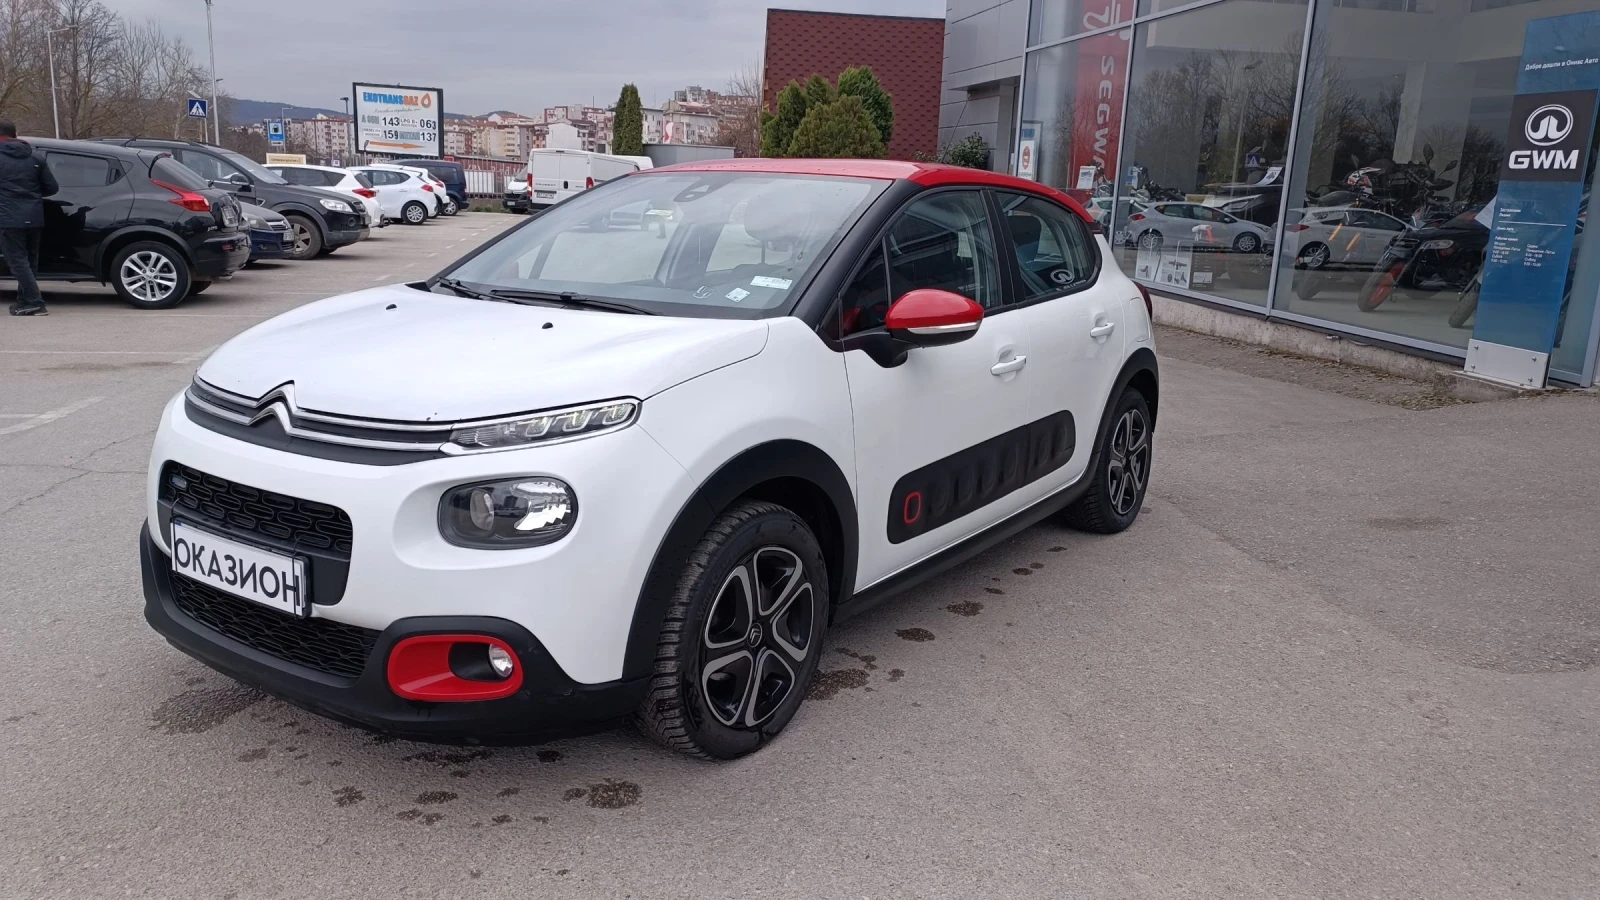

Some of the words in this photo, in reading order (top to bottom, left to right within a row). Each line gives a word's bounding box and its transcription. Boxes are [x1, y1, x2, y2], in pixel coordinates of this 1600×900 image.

[1092, 55, 1114, 169] SEGWA
[382, 117, 400, 126] 143
[420, 119, 437, 130] 063
[383, 130, 399, 140] 159
[421, 132, 437, 142] 137
[1508, 149, 1579, 169] GWM
[175, 537, 302, 607] ОКАЗИОН
